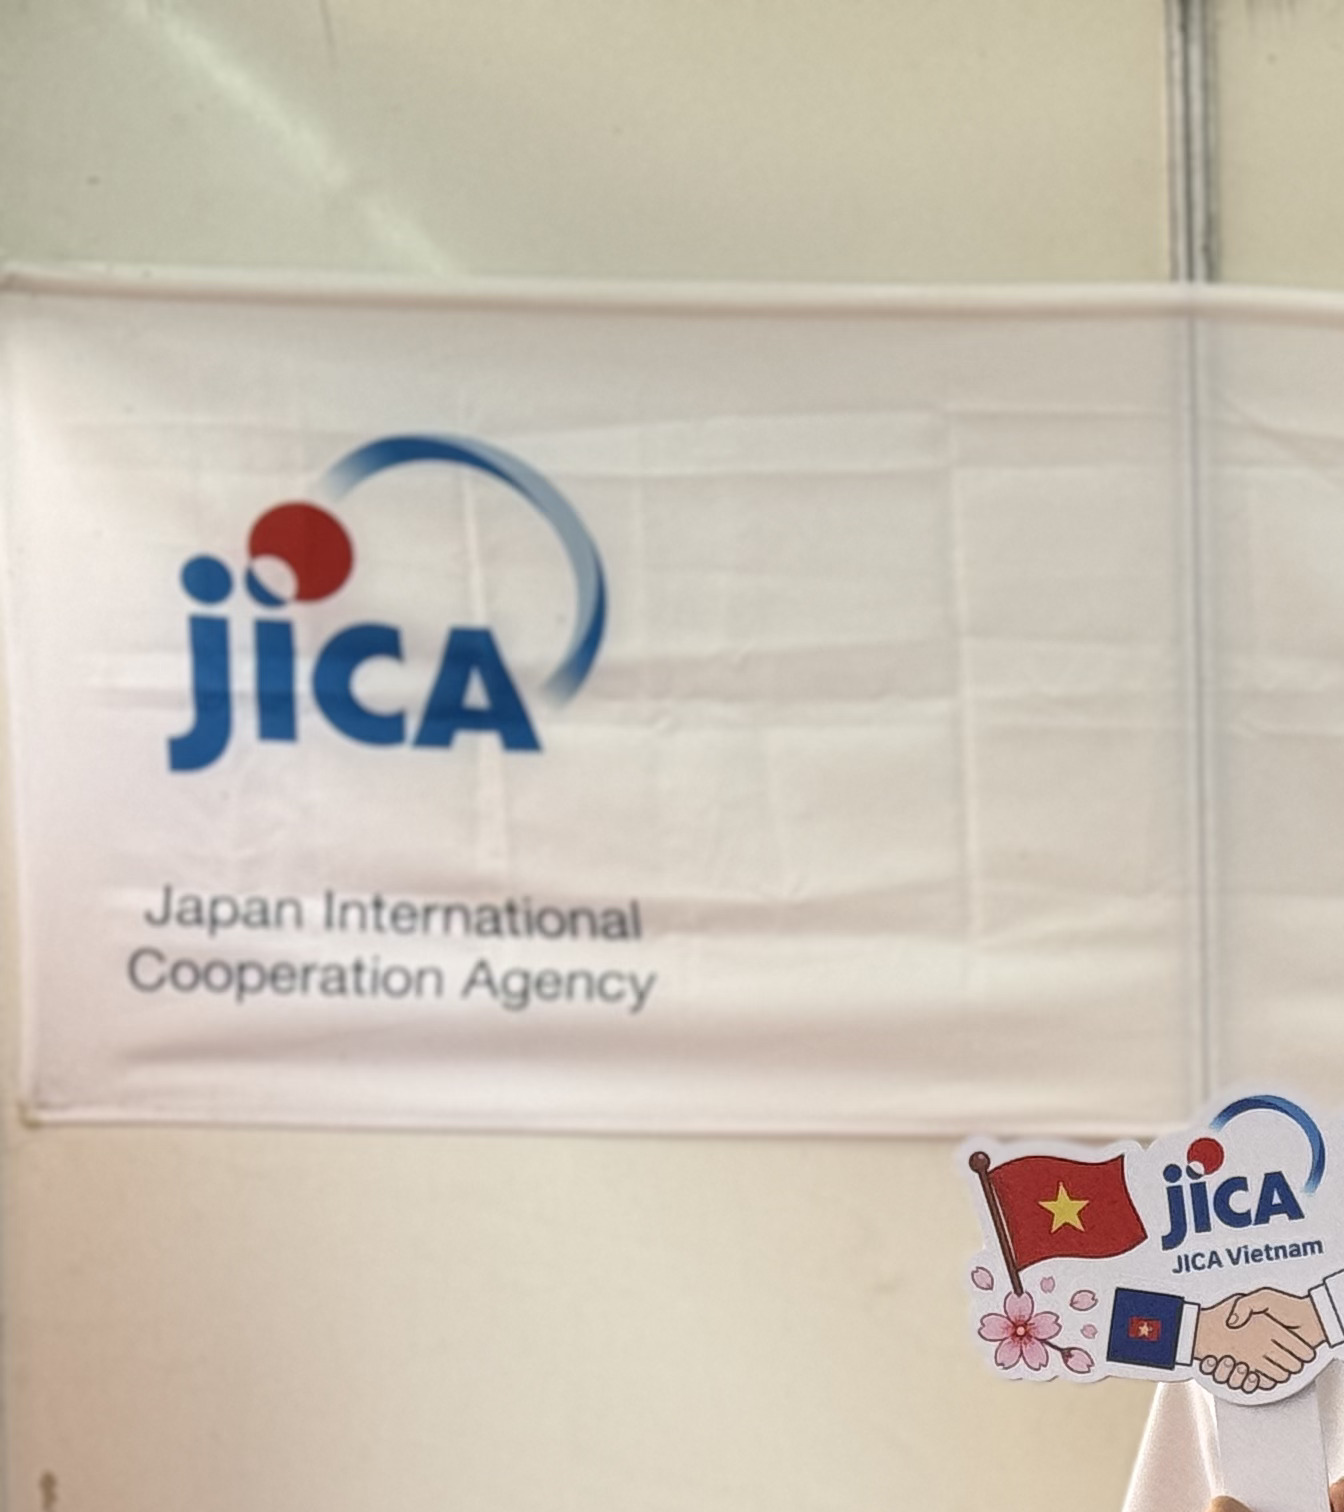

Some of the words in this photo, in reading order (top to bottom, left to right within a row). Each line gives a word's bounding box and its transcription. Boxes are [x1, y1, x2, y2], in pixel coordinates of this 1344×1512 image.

[145, 885, 302, 938] Japan
[324, 890, 643, 941] International
[127, 946, 444, 1003] Cooperation
[461, 958, 658, 1014] Agency
[1171, 1249, 1223, 1275] JICA
[1227, 1237, 1325, 1268] Vietnam
